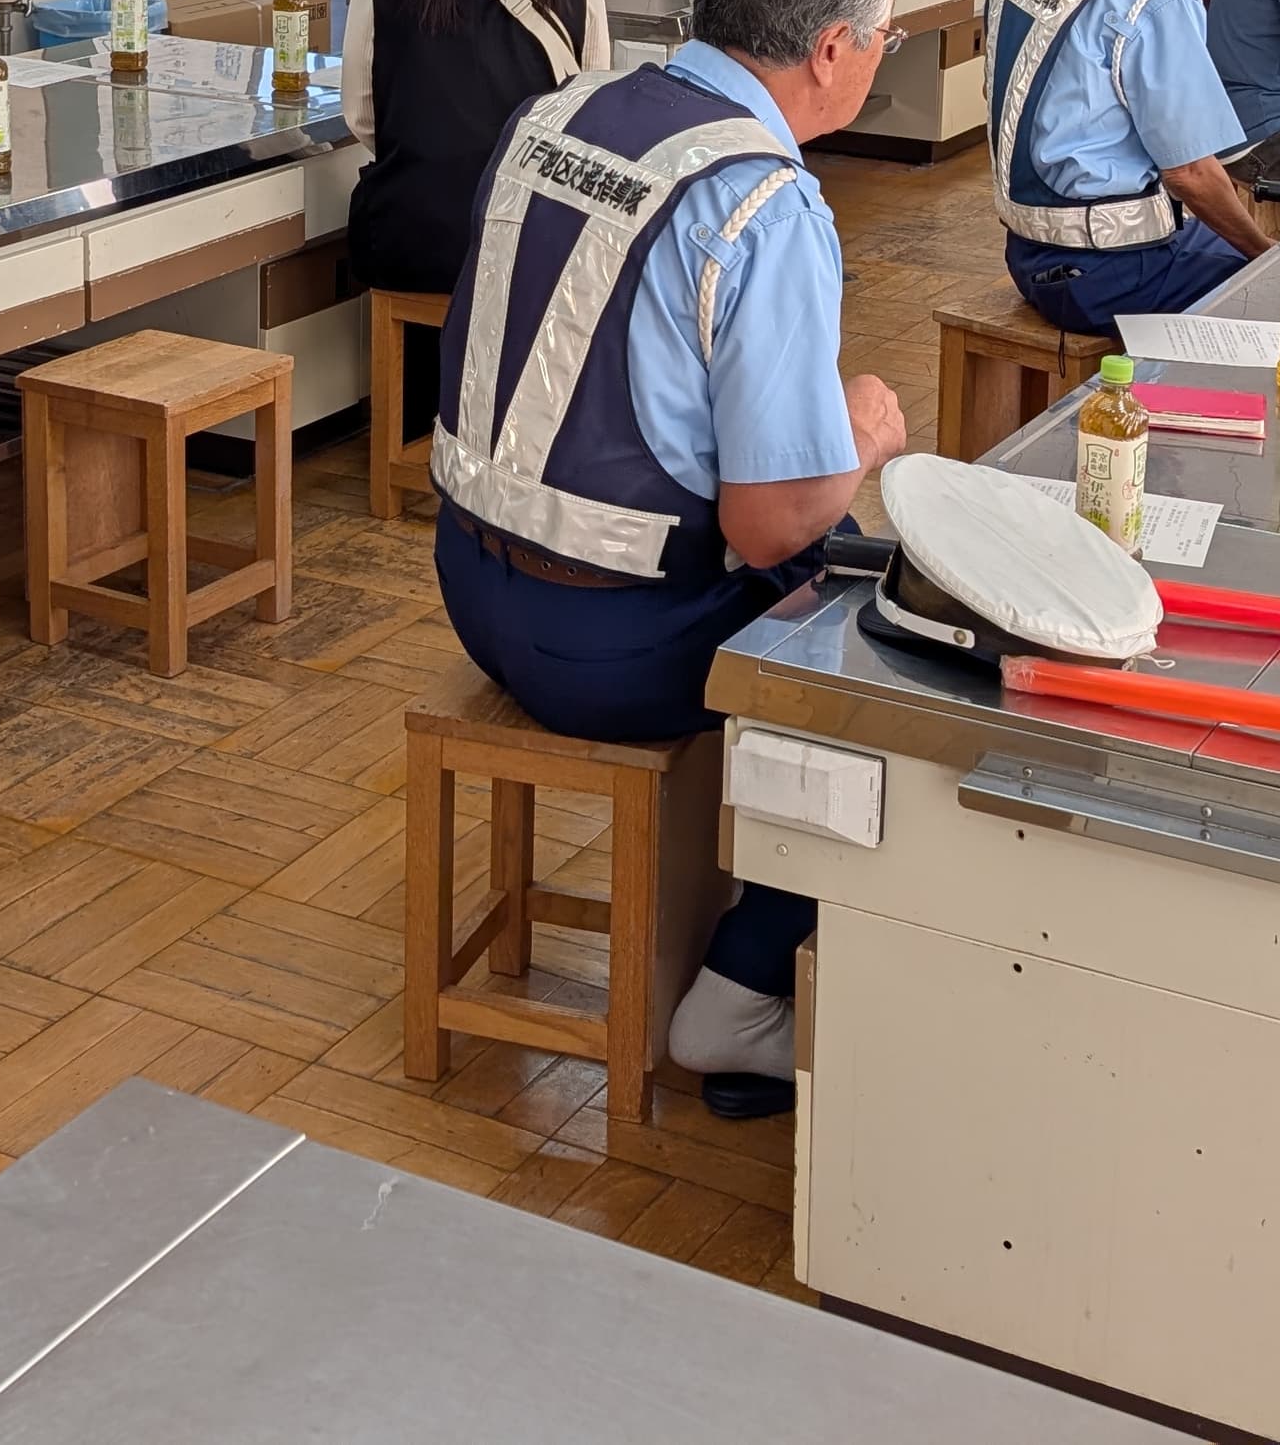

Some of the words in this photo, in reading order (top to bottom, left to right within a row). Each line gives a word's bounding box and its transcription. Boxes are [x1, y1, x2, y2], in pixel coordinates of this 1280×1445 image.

[511, 136, 652, 216] 八戸地区交通指導隊
[1089, 480, 1104, 528] 伊右衛
